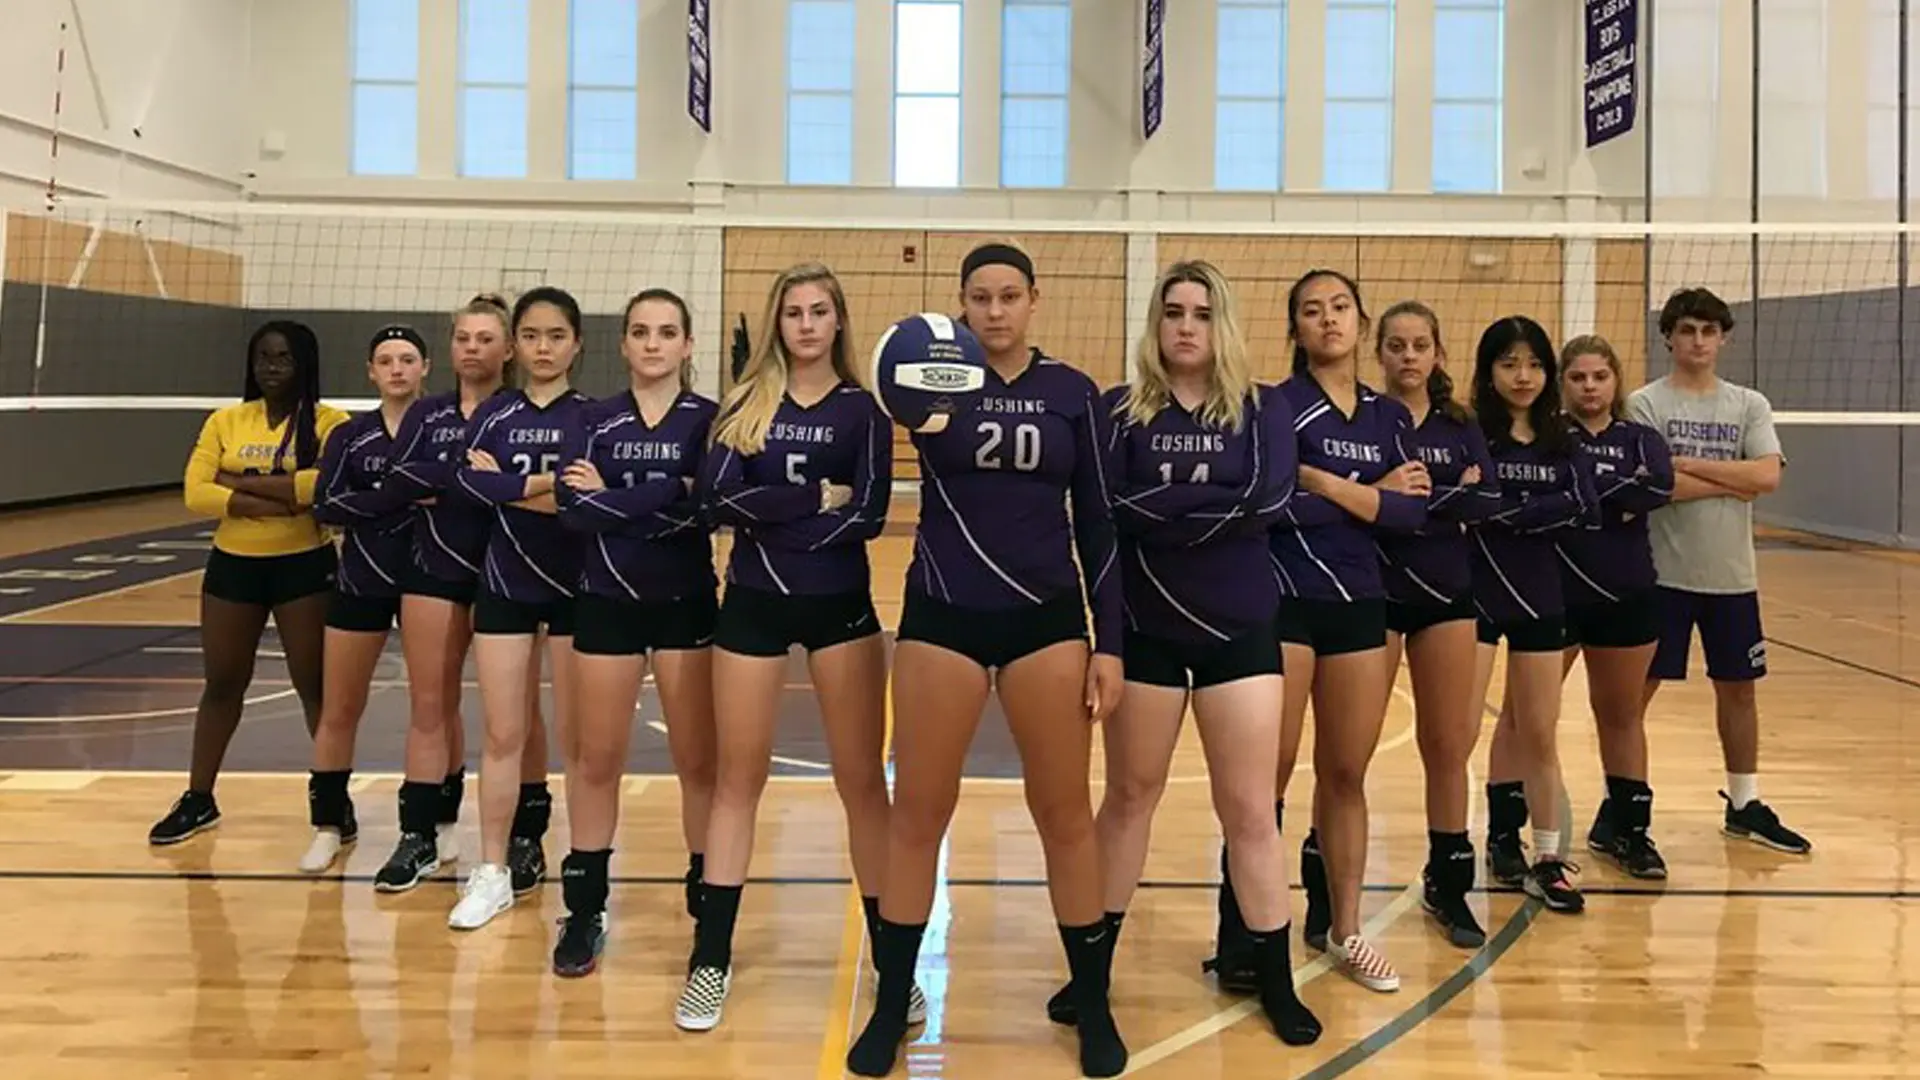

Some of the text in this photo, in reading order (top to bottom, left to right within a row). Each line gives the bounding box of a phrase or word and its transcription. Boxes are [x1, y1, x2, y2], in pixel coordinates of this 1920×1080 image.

[976, 397, 1046, 414] USHING
[431, 427, 466, 443] CUSH
[507, 428, 564, 444] CUSHIN
[1665, 419, 1740, 443] CUSHING
[612, 441, 682, 460] CUSHING
[975, 421, 1041, 471] 20
[1150, 433, 1225, 452] CUSHING
[1323, 437, 1382, 463] CUSHING
[786, 453, 807, 486] 5
[1497, 462, 1557, 482] CUSHING
